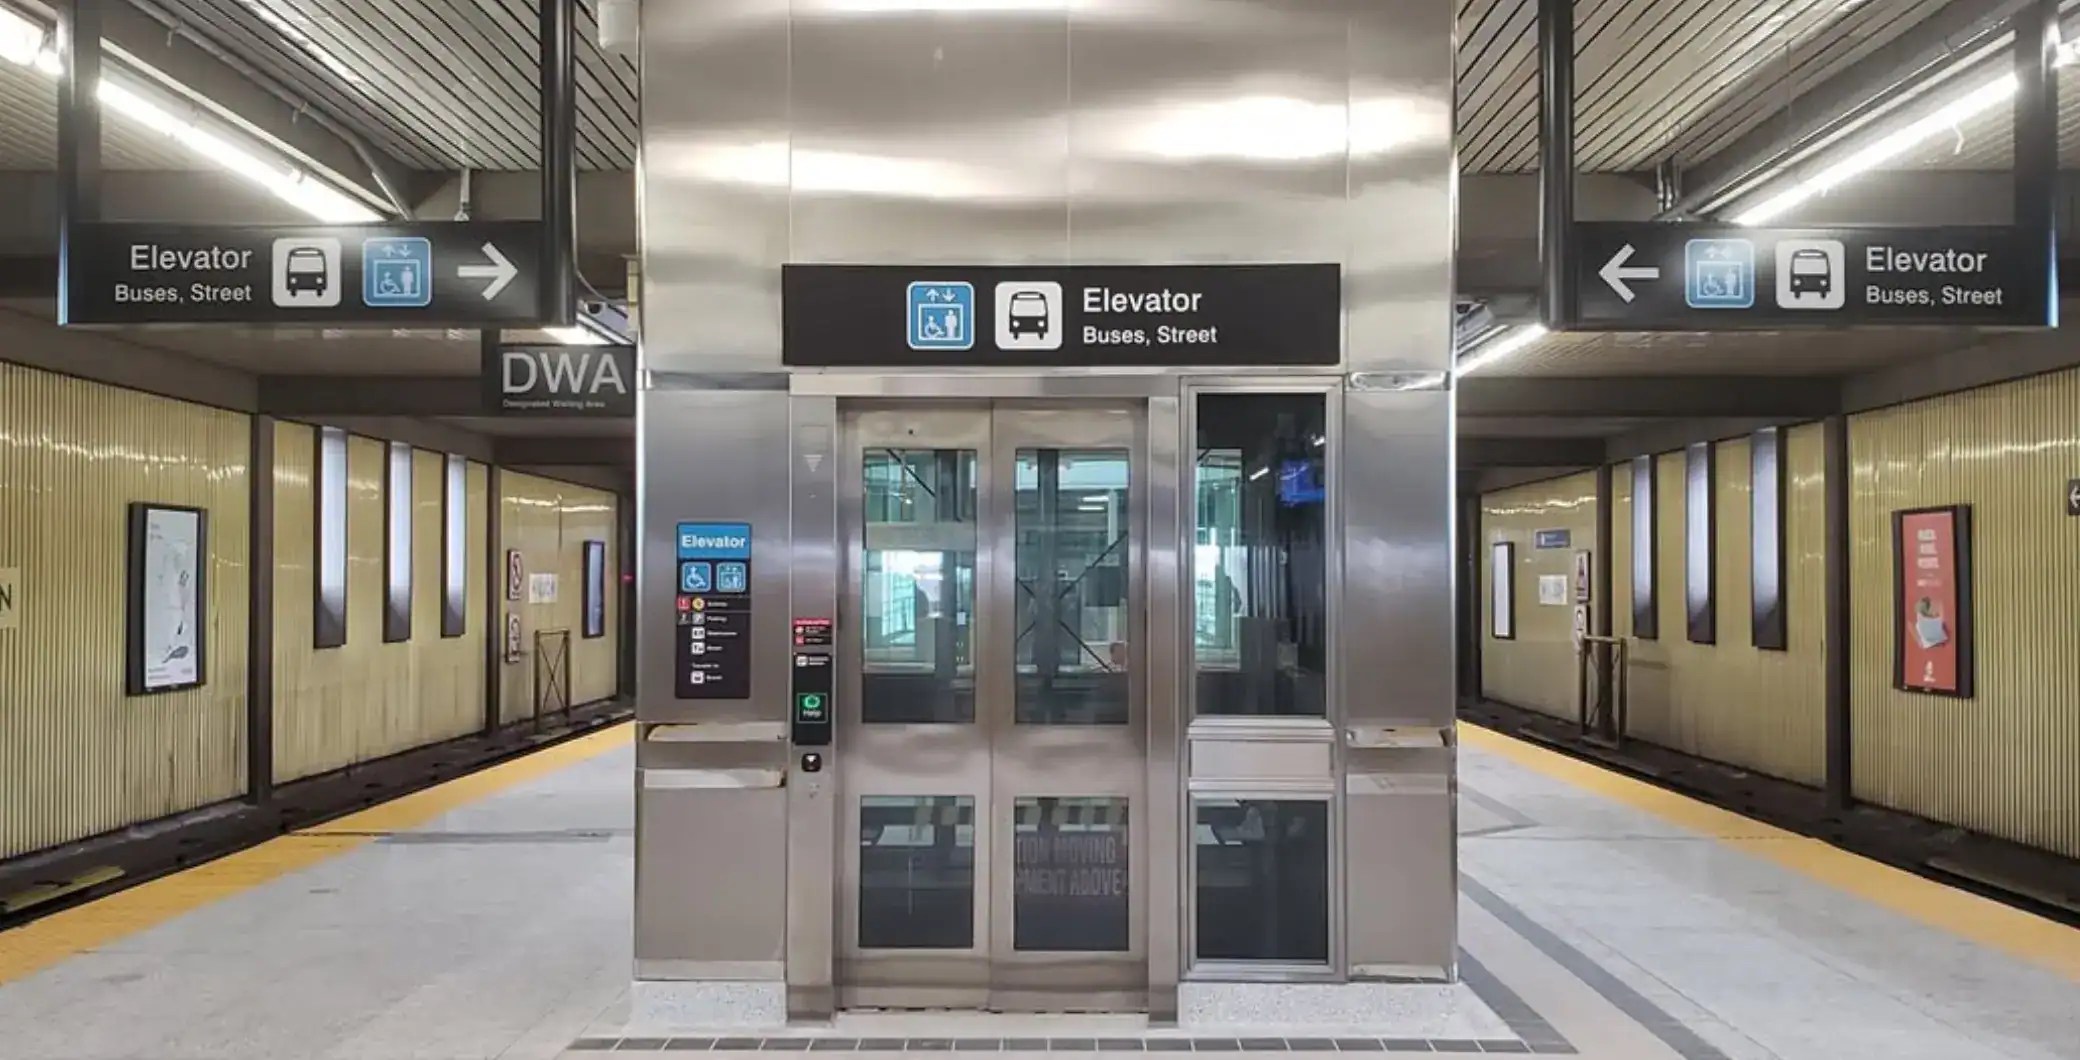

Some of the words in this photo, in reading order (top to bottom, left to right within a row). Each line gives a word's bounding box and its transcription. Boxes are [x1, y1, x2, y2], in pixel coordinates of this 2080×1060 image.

[131, 244, 252, 270] Elevator
[1866, 245, 1988, 272] Elevator
[115, 283, 184, 303] Buses,
[190, 283, 252, 302] Street
[1083, 287, 1202, 312] Elevator
[1866, 285, 1935, 306] Buses,
[1941, 284, 2002, 305] Street
[1083, 325, 1150, 346] Buses,
[1157, 325, 1217, 343] Street
[502, 352, 627, 394] DWA
[682, 535, 746, 548] Elevator
